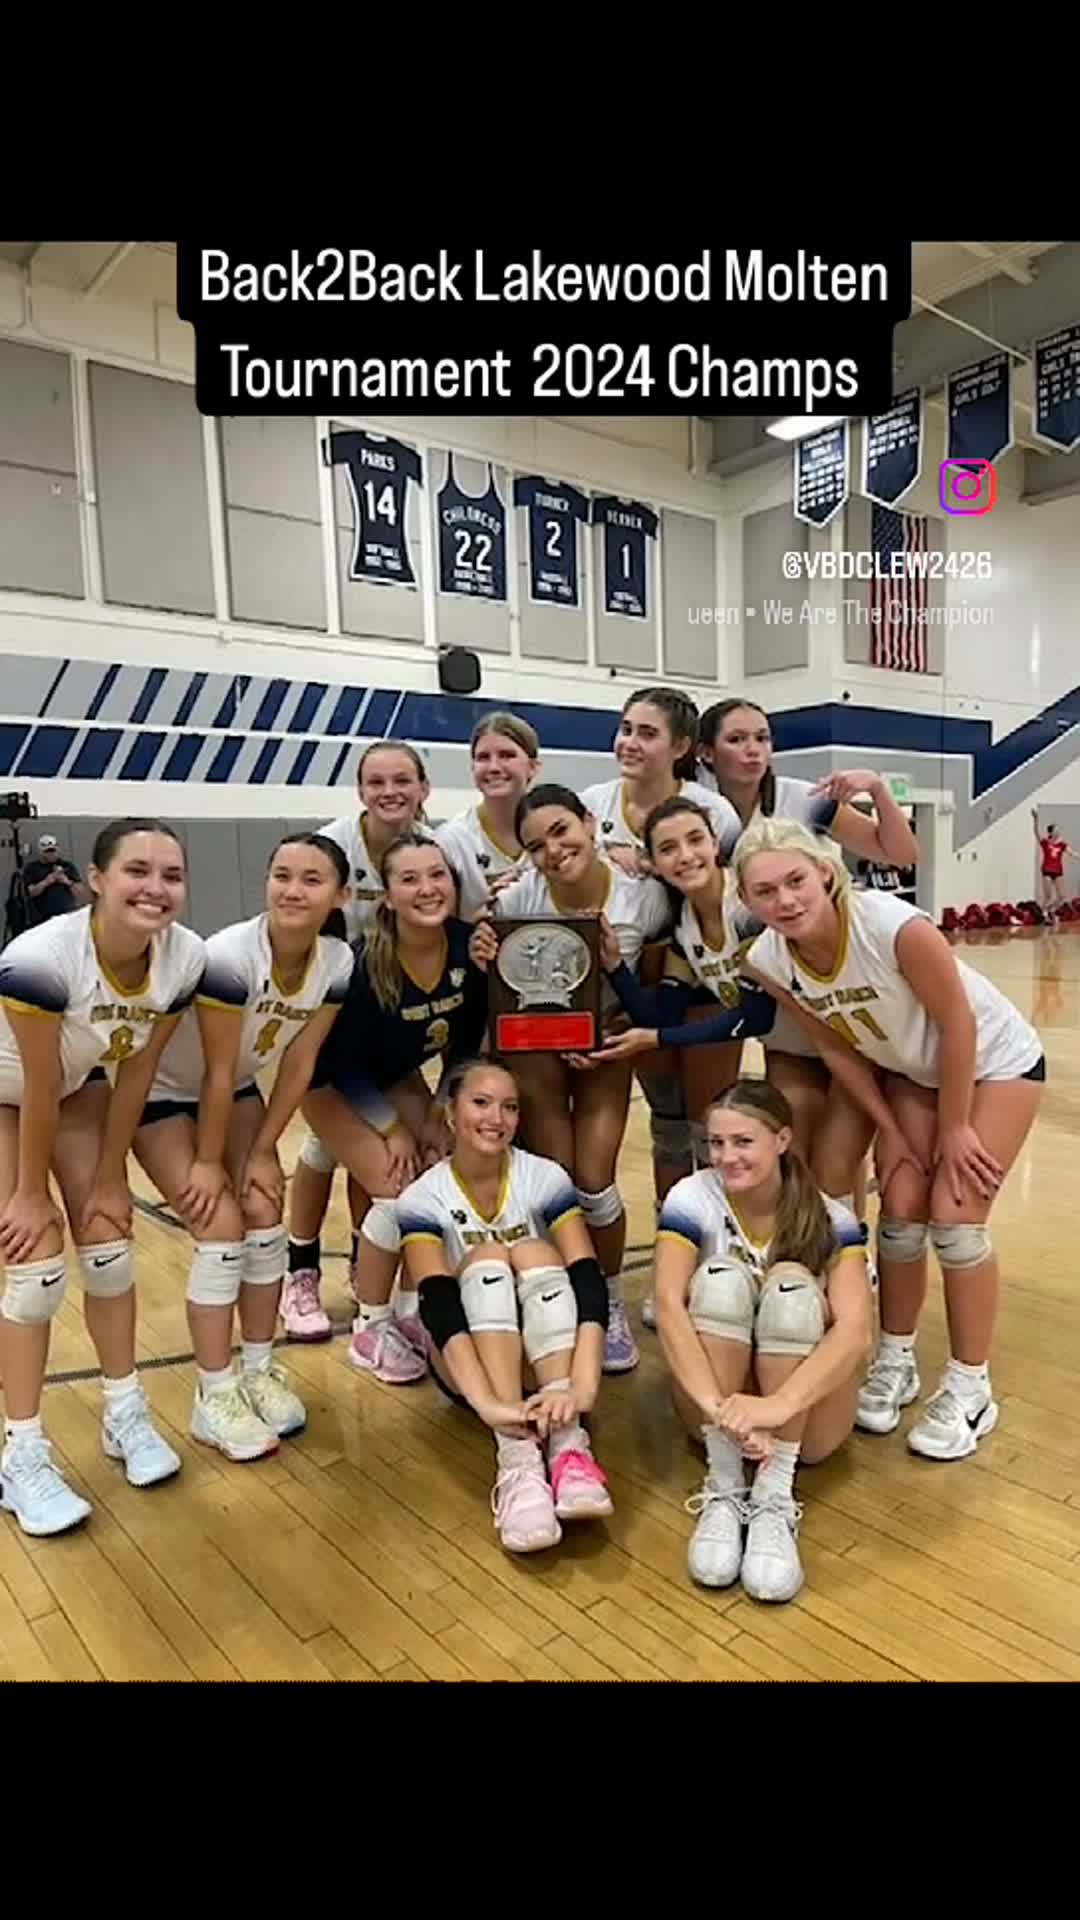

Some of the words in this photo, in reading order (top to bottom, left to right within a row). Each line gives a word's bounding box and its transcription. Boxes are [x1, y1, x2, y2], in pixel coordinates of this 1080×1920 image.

[360, 448, 396, 472] PARKS
[363, 480, 398, 527] 14
[454, 528, 493, 573] 22
[545, 520, 562, 558] 2
[621, 543, 630, 579] 1
